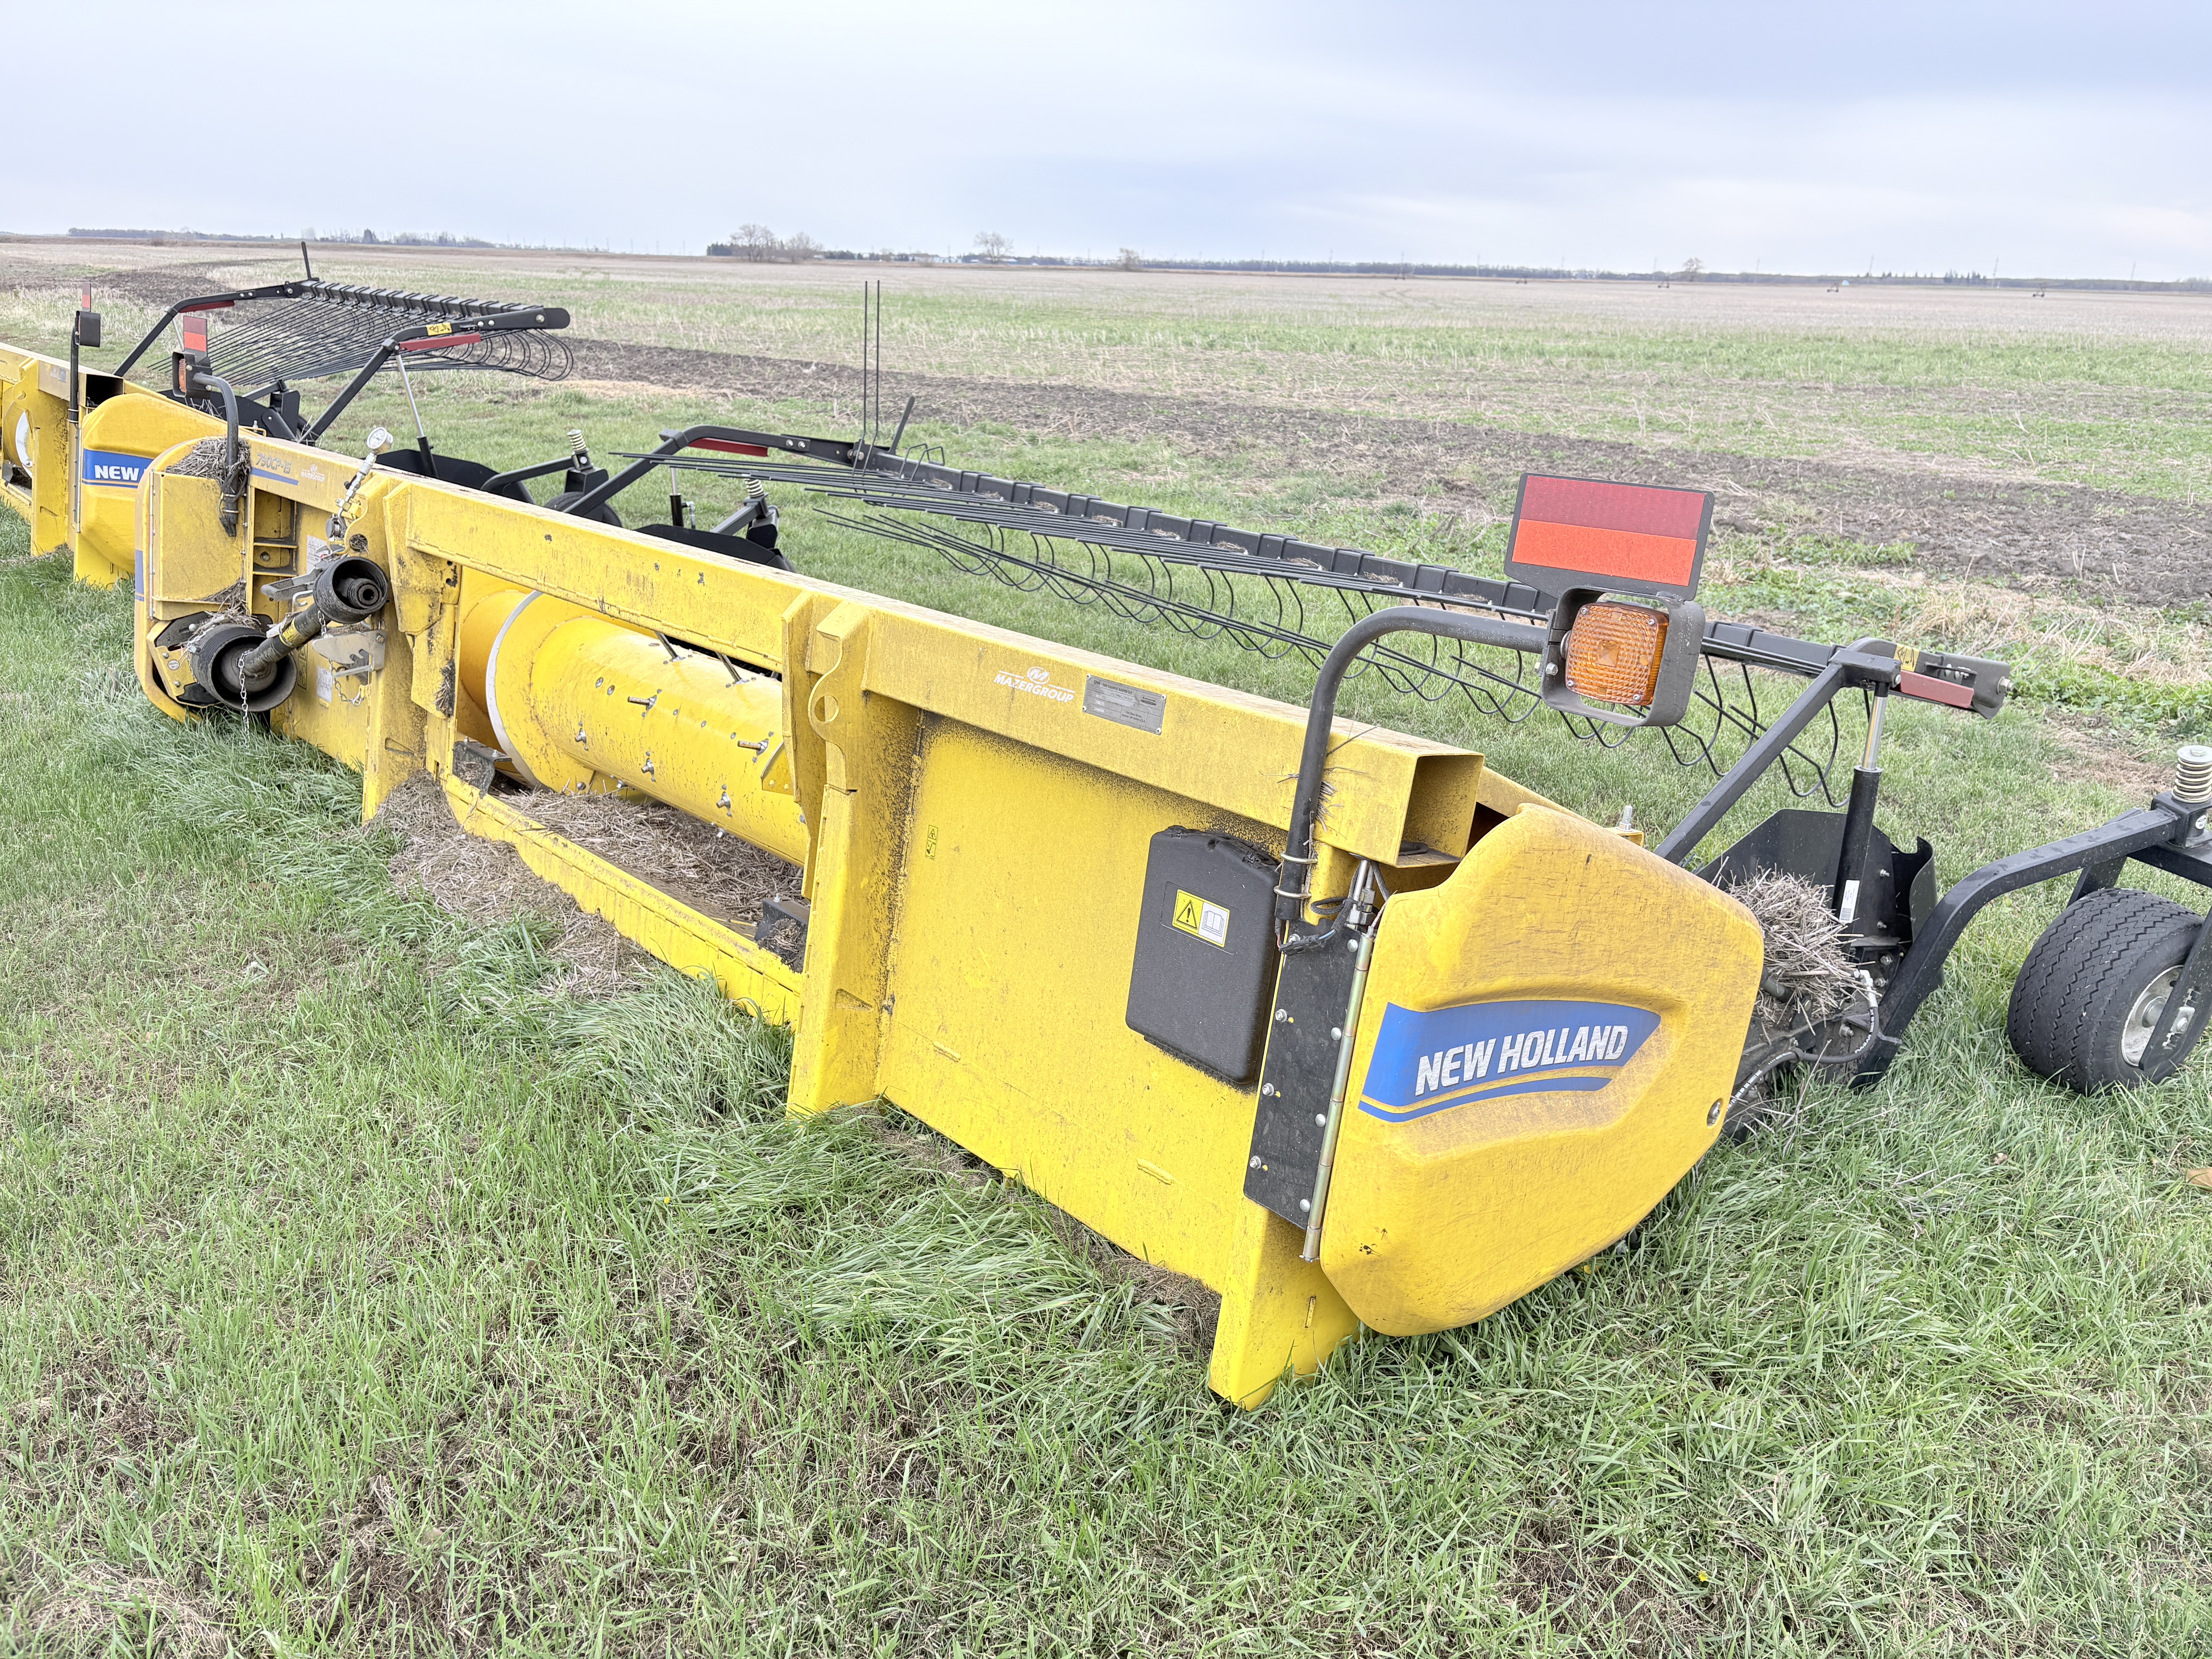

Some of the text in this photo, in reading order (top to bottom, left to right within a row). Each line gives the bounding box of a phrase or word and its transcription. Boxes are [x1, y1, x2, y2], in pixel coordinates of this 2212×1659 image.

[94, 465, 139, 481] NEW
[256, 452, 292, 474] 790CP-15
[994, 674, 1075, 703] MAZERGROUP
[1855, 1034, 1872, 1054] PULSAR
[1415, 1025, 1628, 1096] NEW HOLLAND
